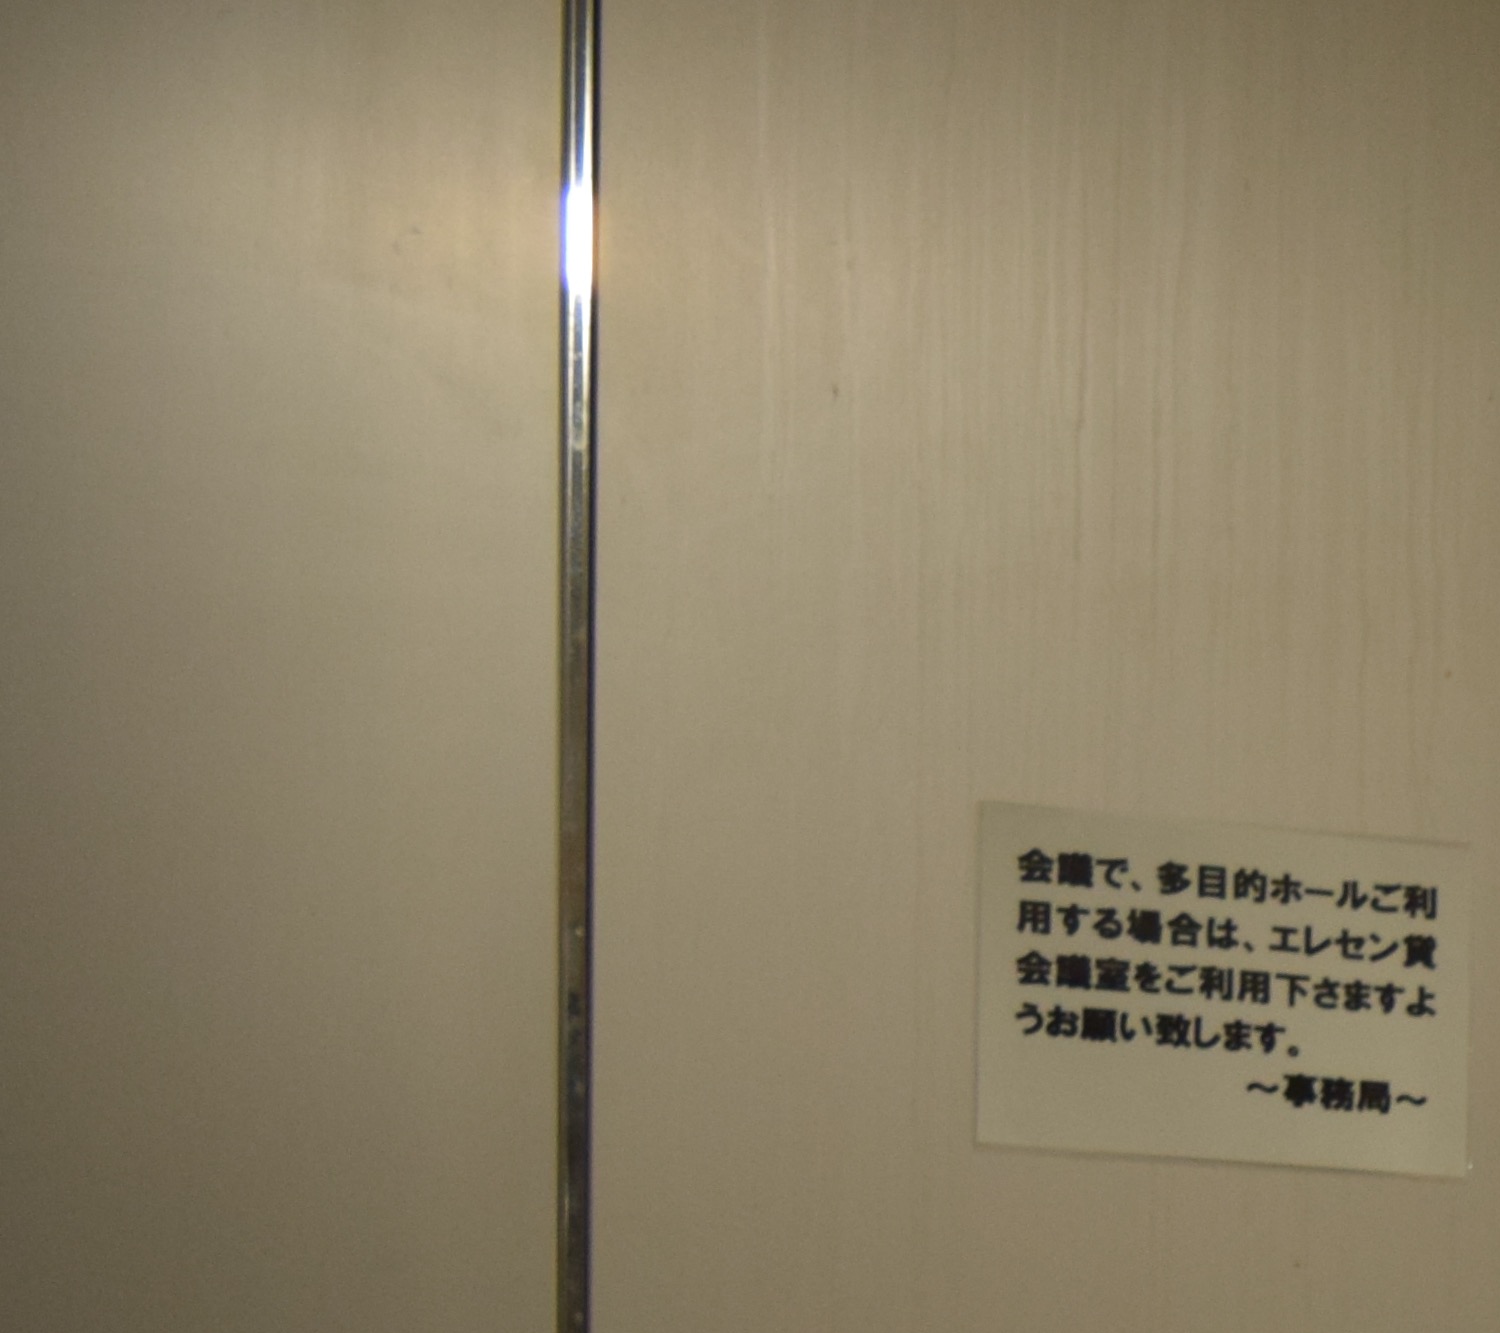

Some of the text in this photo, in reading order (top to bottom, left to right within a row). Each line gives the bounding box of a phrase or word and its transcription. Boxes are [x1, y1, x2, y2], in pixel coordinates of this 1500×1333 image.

[1017, 848, 1439, 920] 会議で、多目的ホールご利
[1016, 899, 1438, 970] 用する場合は、エレセン貸
[1016, 951, 1438, 1018] 会議室をご利用下さますよ
[1015, 1001, 1301, 1058] うお願い致します。
